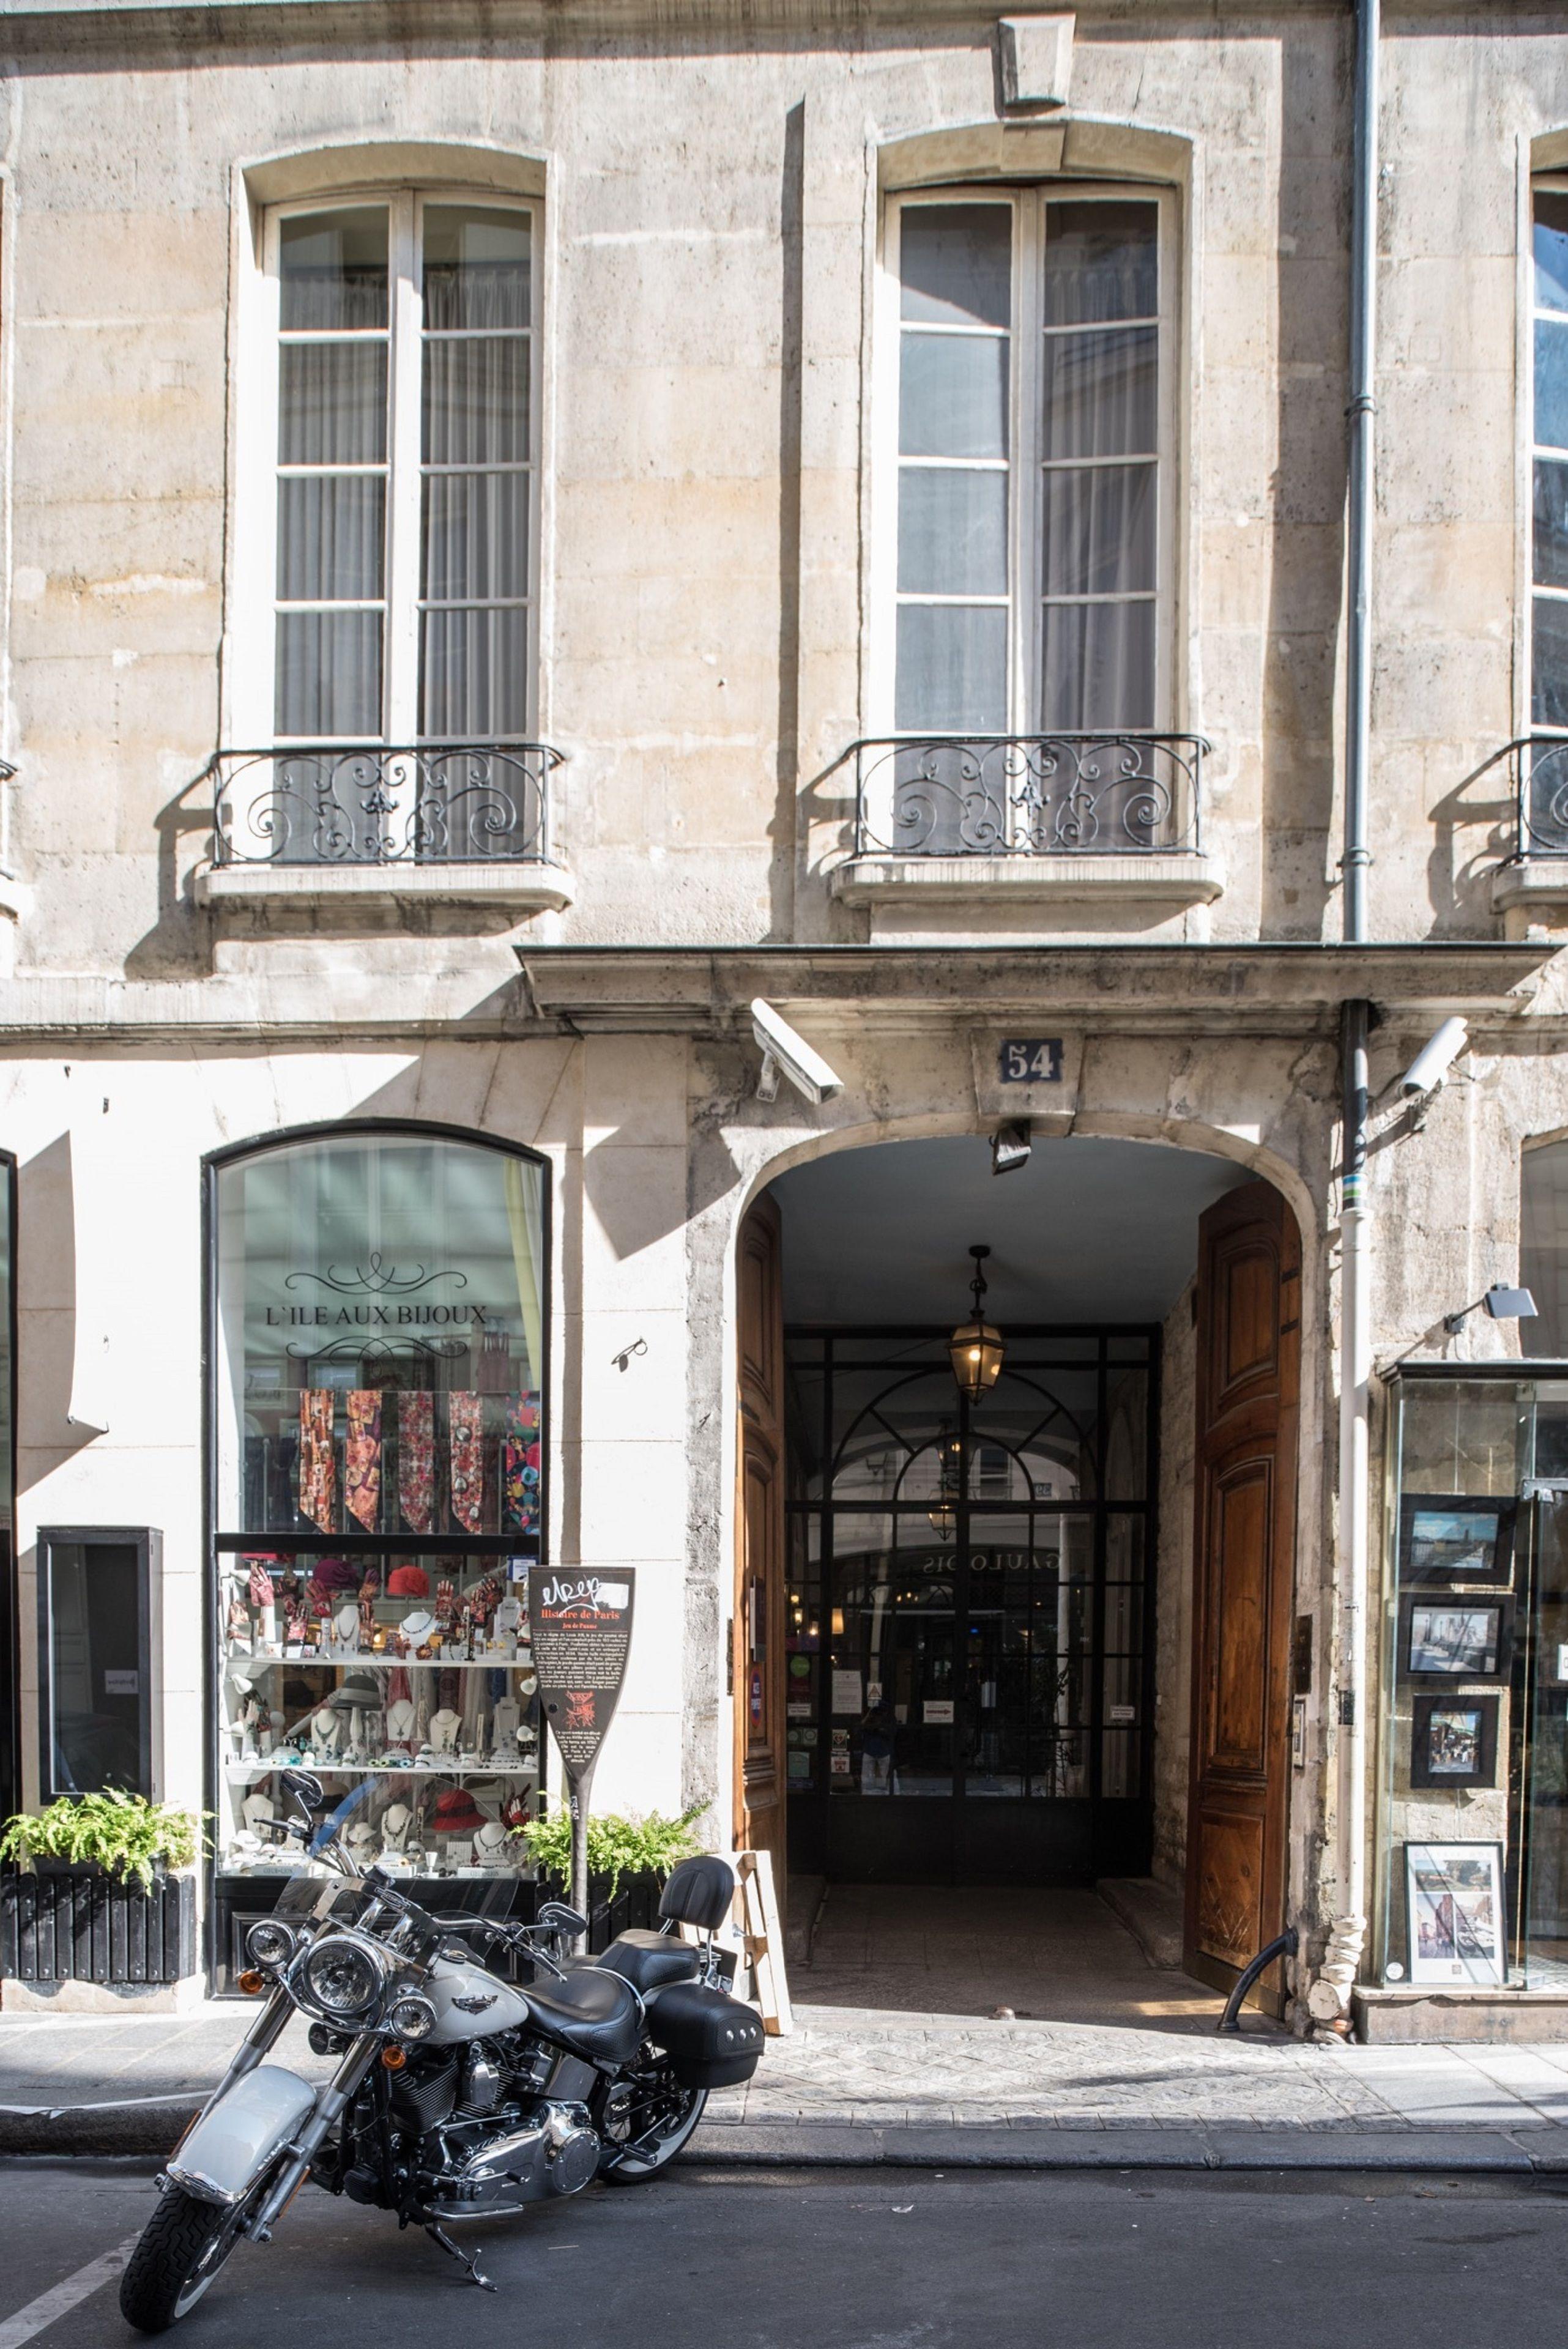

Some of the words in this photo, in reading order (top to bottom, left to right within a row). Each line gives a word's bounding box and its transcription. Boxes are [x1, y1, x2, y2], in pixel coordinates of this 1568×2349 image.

[1008, 1044, 1054, 1078] 54
[336, 1306, 390, 1325] AUX
[398, 1305, 487, 1324] BIJOUX
[541, 1609, 578, 1619] Histire
[580, 1610, 591, 1619] de
[594, 1610, 620, 1620] Paris
